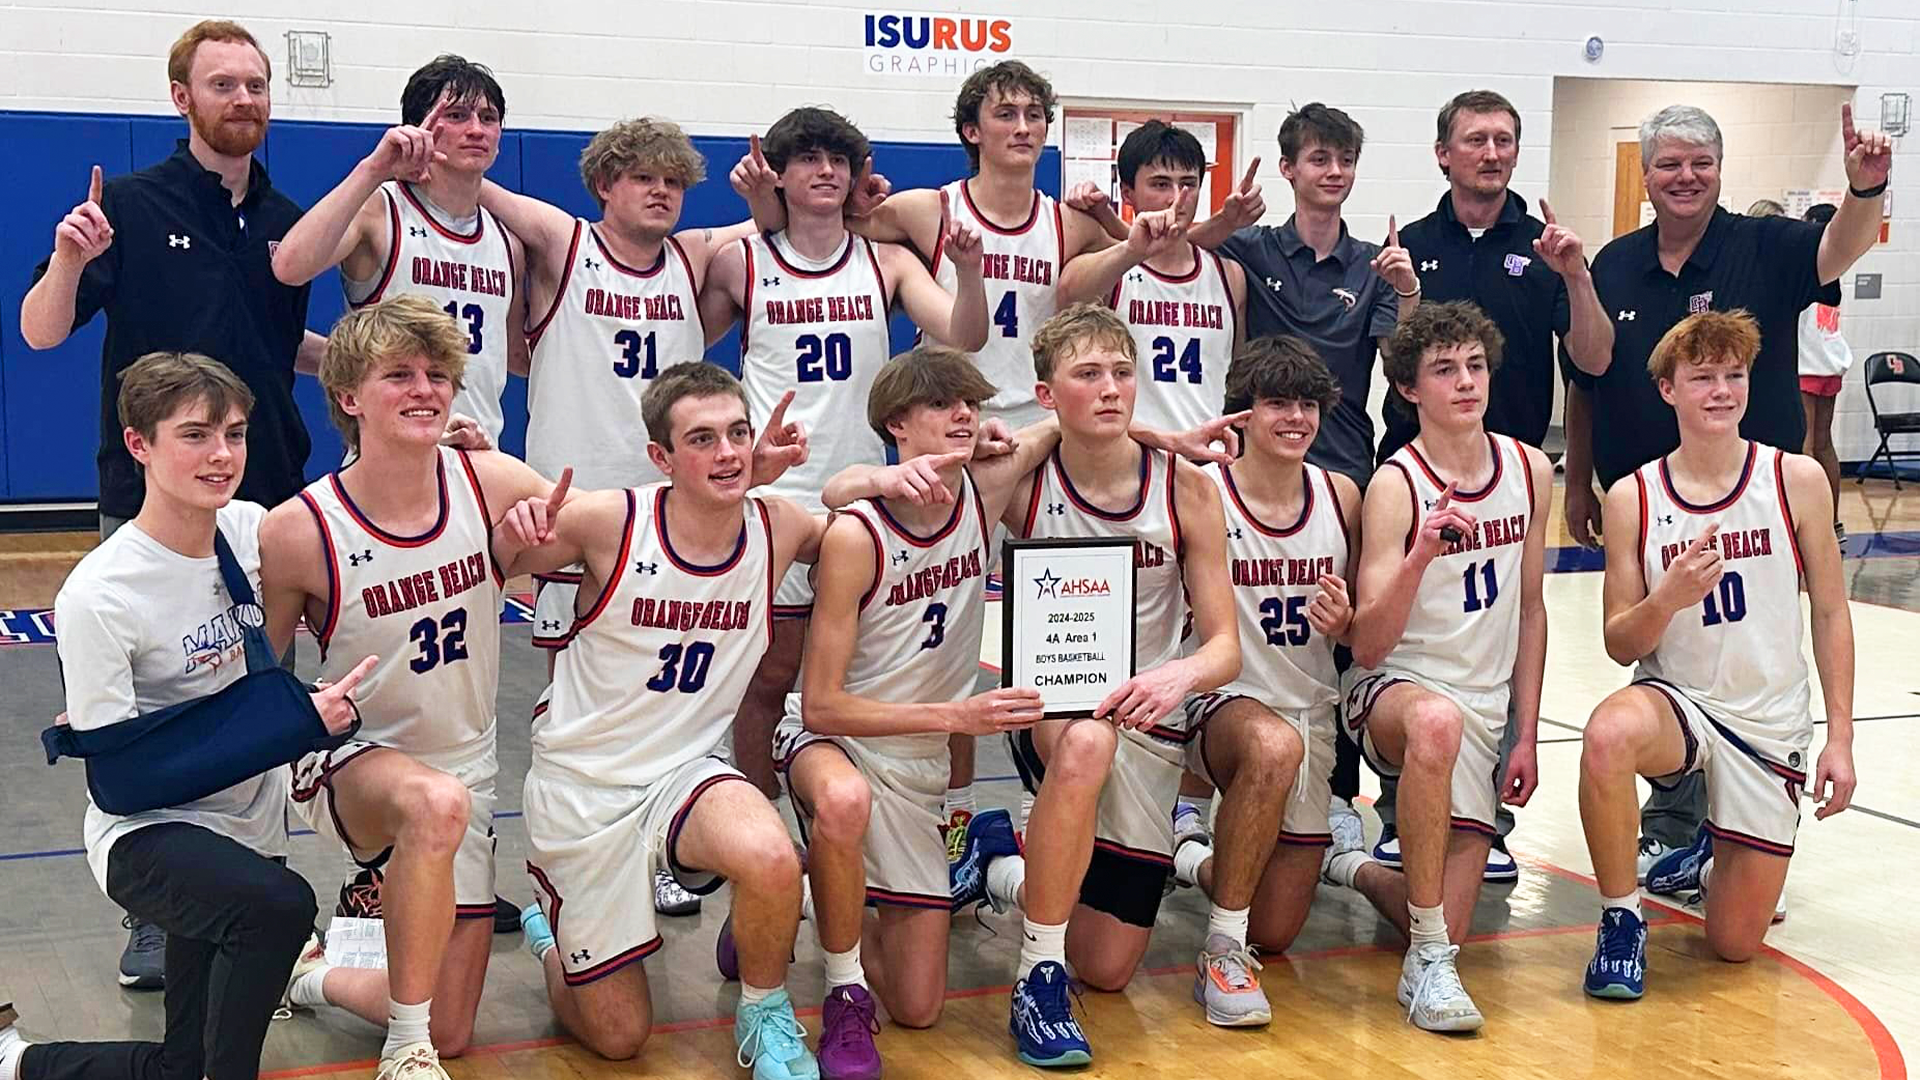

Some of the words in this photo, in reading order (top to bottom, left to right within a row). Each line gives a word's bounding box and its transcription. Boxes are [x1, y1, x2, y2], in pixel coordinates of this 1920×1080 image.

[865, 14, 1012, 53] ISURUS
[412, 256, 467, 291] ORANGE
[470, 265, 506, 297] BEACH
[981, 253, 1010, 280] NGE
[1013, 255, 1052, 286] BEACH
[585, 288, 641, 320] ORANGE
[766, 297, 824, 325] ORANGE
[827, 295, 874, 322] BEACH
[993, 291, 1018, 338] 4
[1129, 299, 1180, 327] ORANGE
[1183, 302, 1223, 330] BEACH
[613, 329, 660, 380] 31
[795, 332, 852, 383] 20
[1152, 335, 1203, 385] 24
[1721, 528, 1773, 560] BEACH
[362, 569, 440, 618] ORANGE
[438, 551, 487, 599] BEACH
[1061, 579, 1111, 594] AHSAA
[1232, 558, 1286, 587] ORANGE
[1463, 558, 1499, 613] 11
[1048, 611, 1096, 624] 2024-2025
[1702, 570, 1747, 627] 10
[409, 606, 469, 675] 32
[921, 602, 948, 651] 3
[1046, 633, 1060, 644] 4A
[1065, 632, 1089, 643] Area
[1092, 631, 1097, 642] 1
[1258, 596, 1311, 647] 25
[646, 641, 716, 694] 30
[1035, 654, 1056, 664] BOYS
[1058, 651, 1106, 662] BASKETBALL
[1034, 672, 1107, 686] CHAMPION
